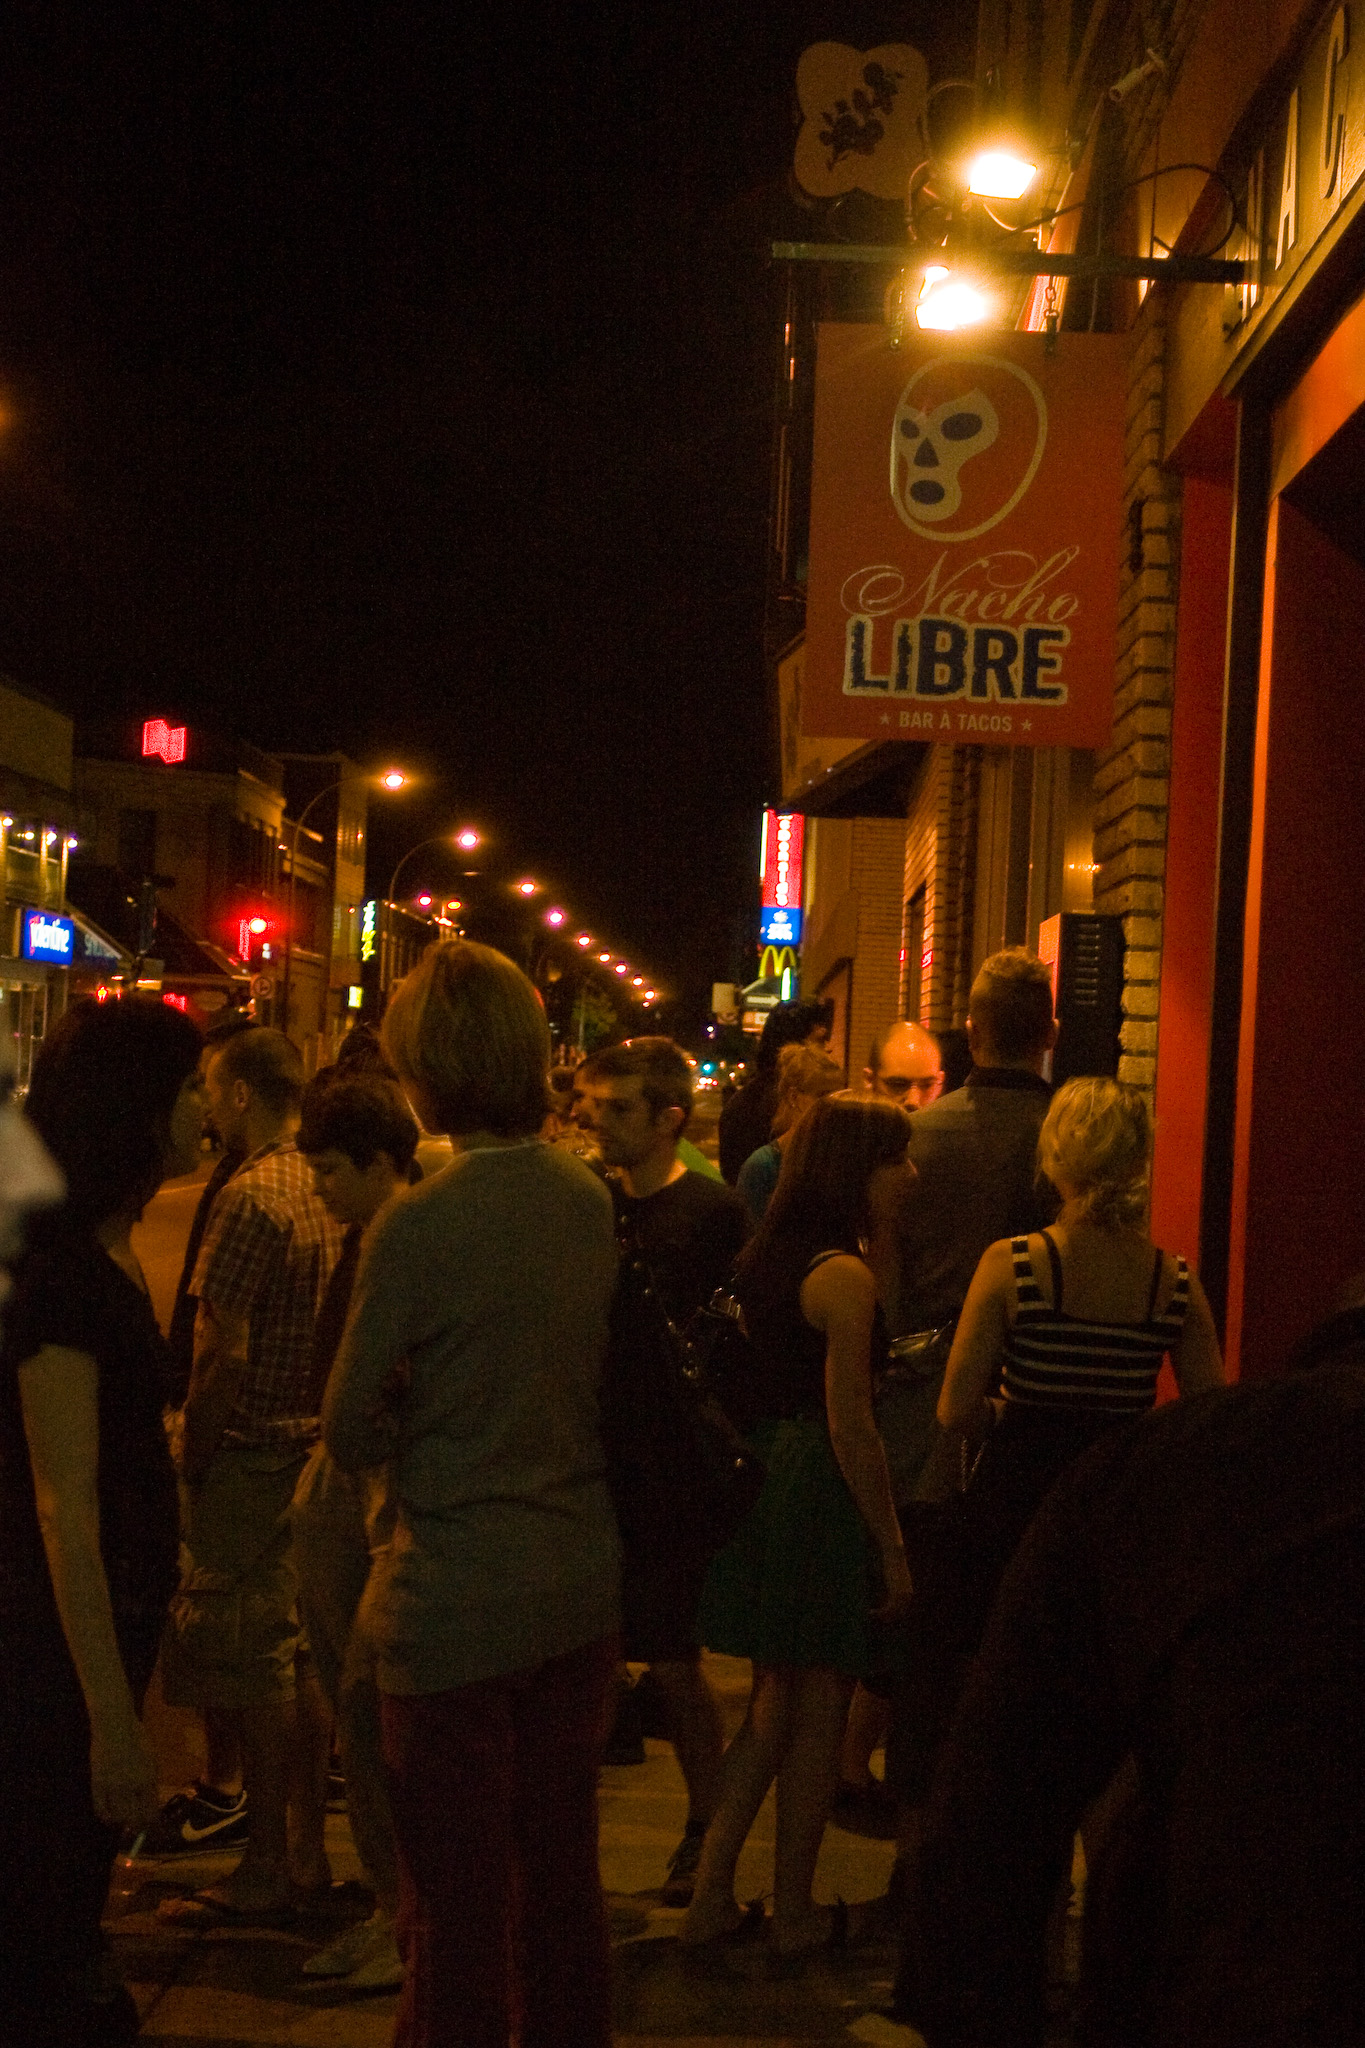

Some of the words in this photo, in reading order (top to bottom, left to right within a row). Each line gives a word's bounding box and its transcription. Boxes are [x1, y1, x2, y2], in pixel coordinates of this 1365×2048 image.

[840, 545, 1082, 623] Nacho
[843, 615, 1072, 704] LIBRE
[898, 711, 934, 730] BAR
[957, 713, 1013, 733] TACOS
